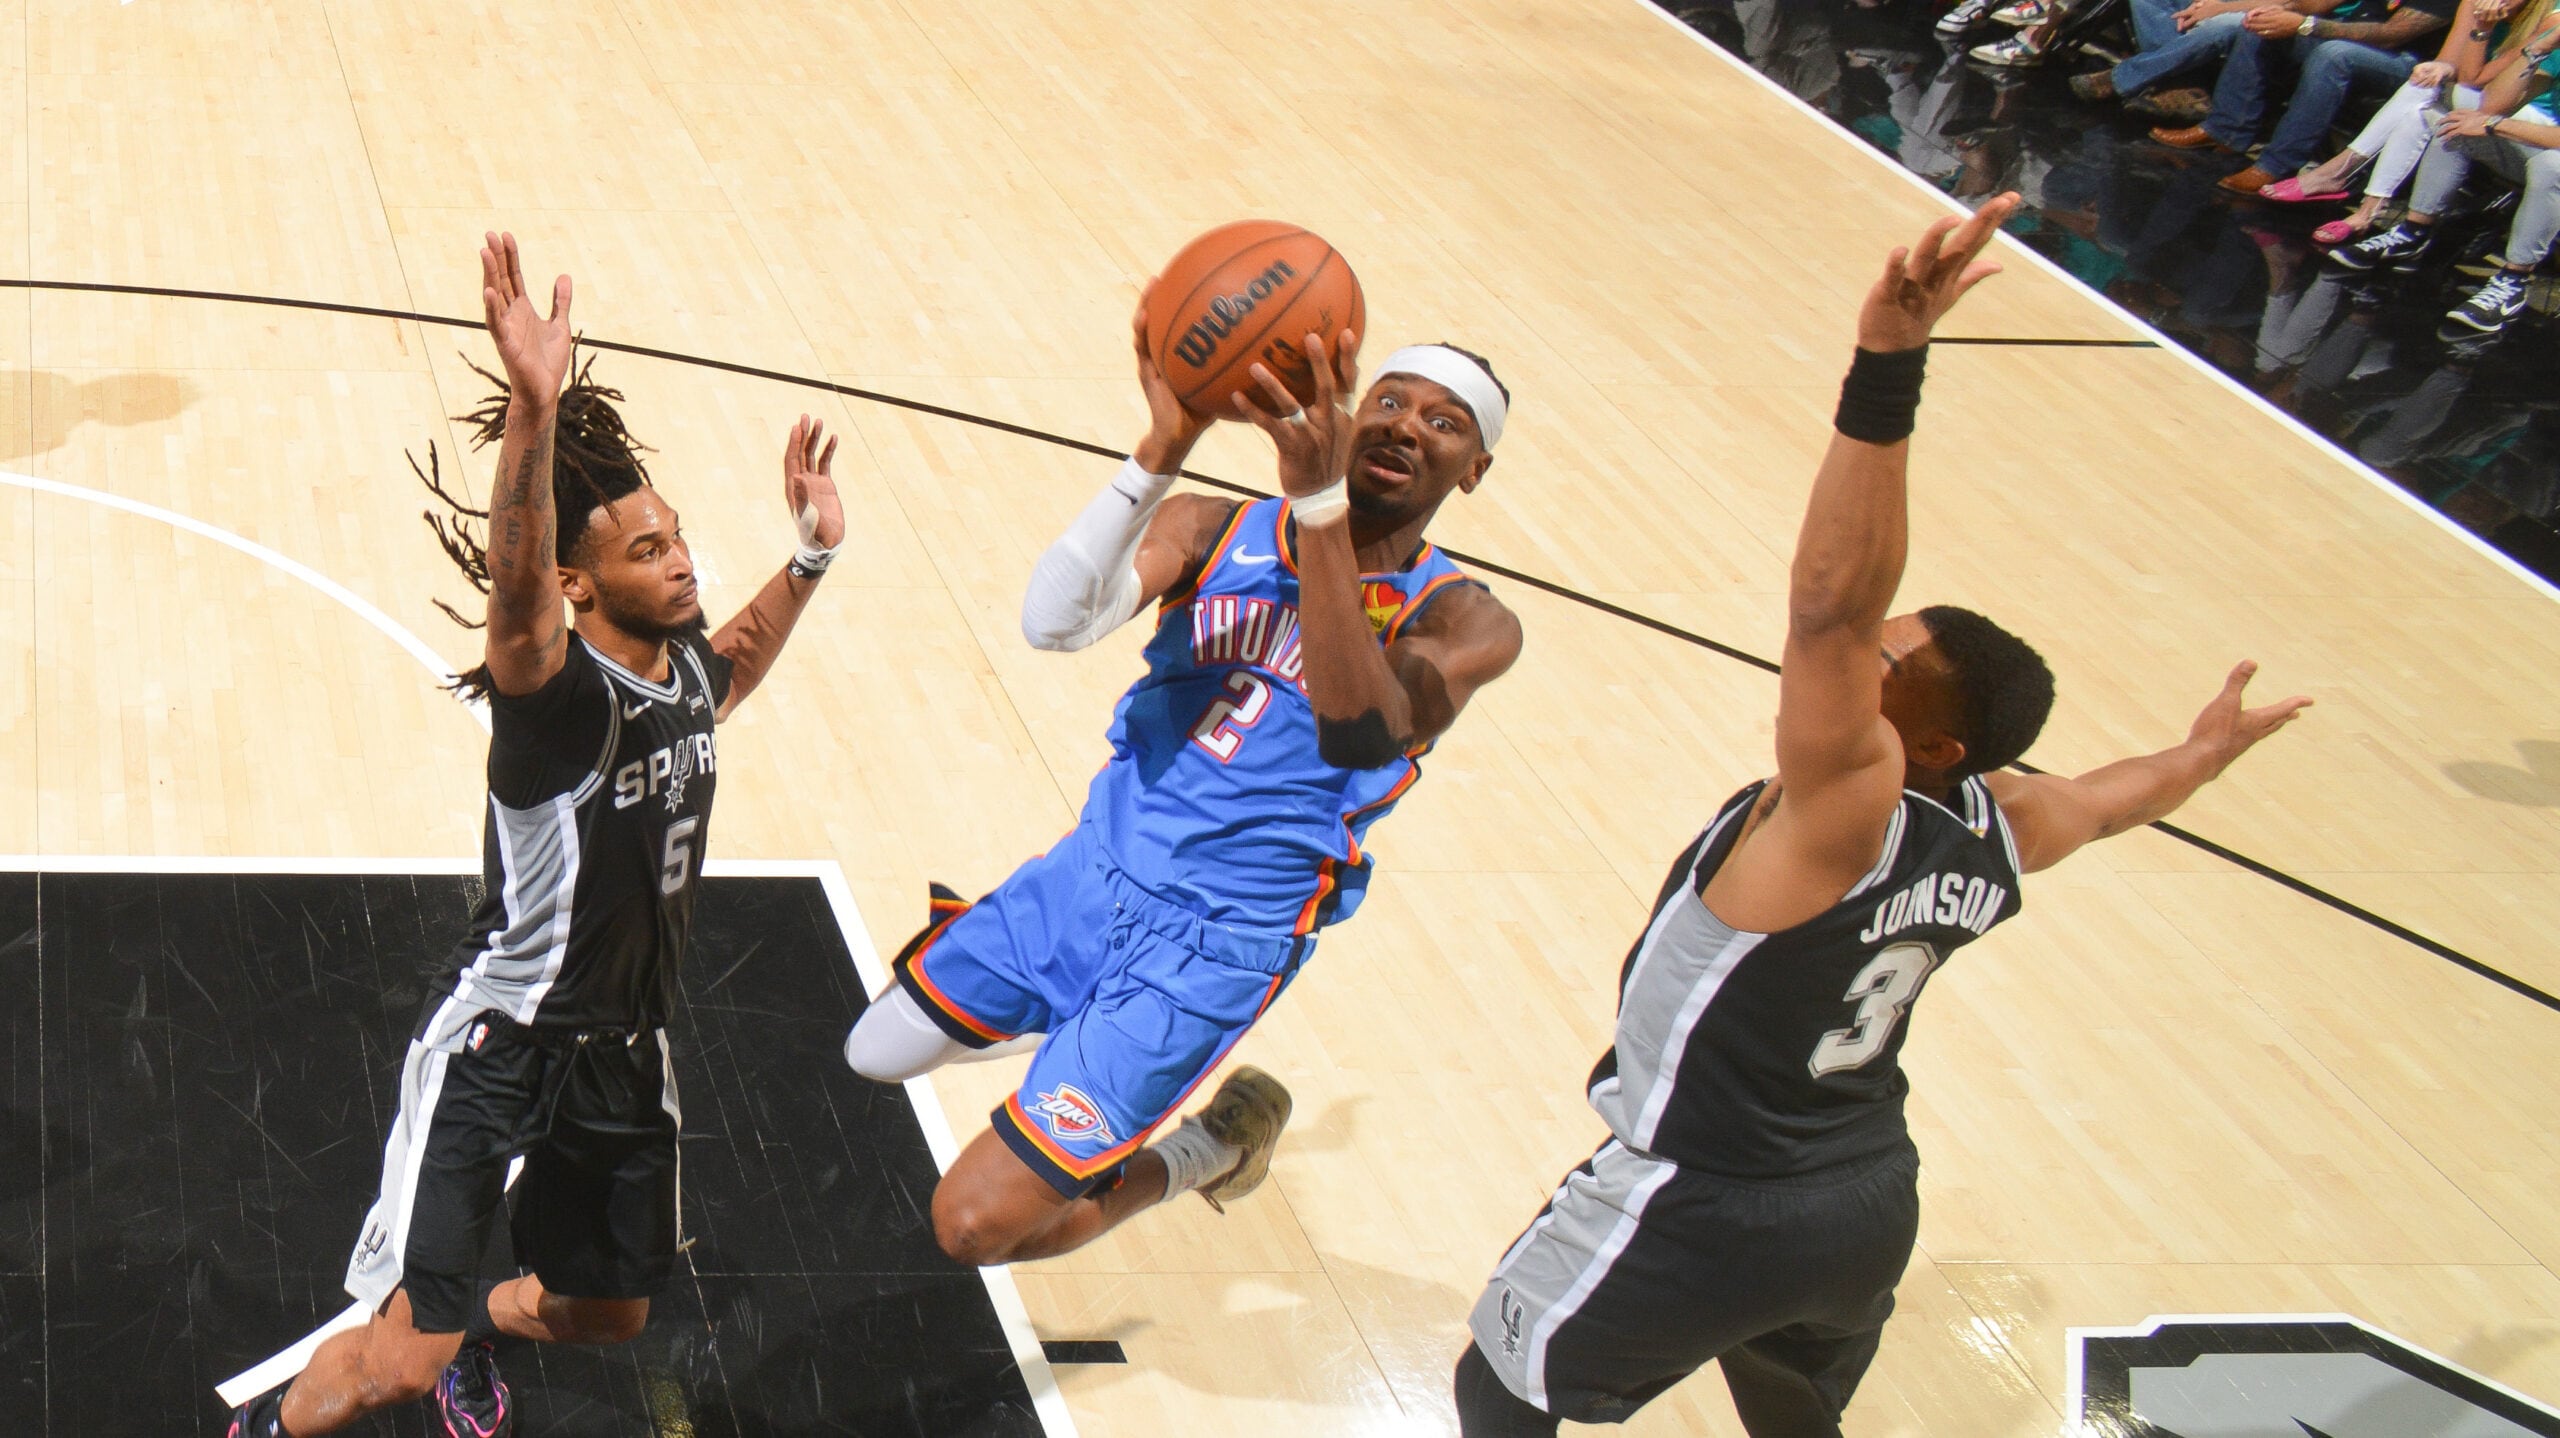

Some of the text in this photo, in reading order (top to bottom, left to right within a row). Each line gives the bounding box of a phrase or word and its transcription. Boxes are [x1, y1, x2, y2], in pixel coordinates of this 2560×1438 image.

[1174, 259, 1297, 369] Wilson
[1187, 668, 1272, 764] 2
[615, 733, 717, 813] SPUR
[661, 815, 699, 895] 5
[1808, 941, 1938, 1079] 3
